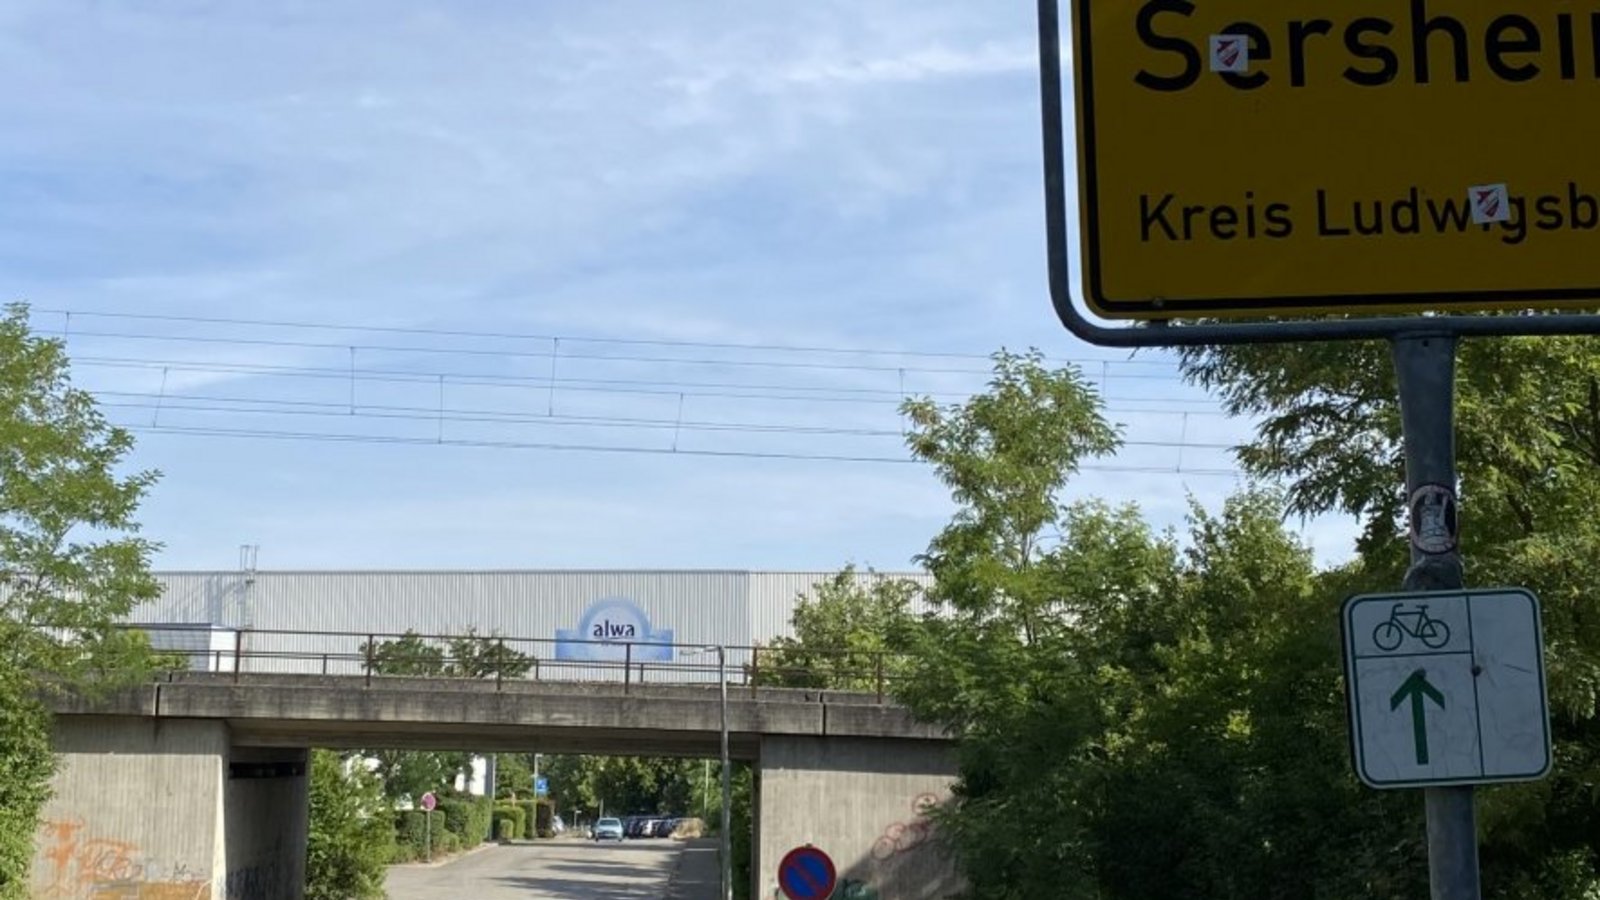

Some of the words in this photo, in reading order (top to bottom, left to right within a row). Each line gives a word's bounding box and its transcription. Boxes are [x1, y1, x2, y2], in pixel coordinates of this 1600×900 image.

[1135, 0, 1600, 91] Sershei
[1140, 191, 1293, 241] Kreis
[1316, 182, 1599, 244] Ludwgsb
[593, 619, 635, 636] alwa
